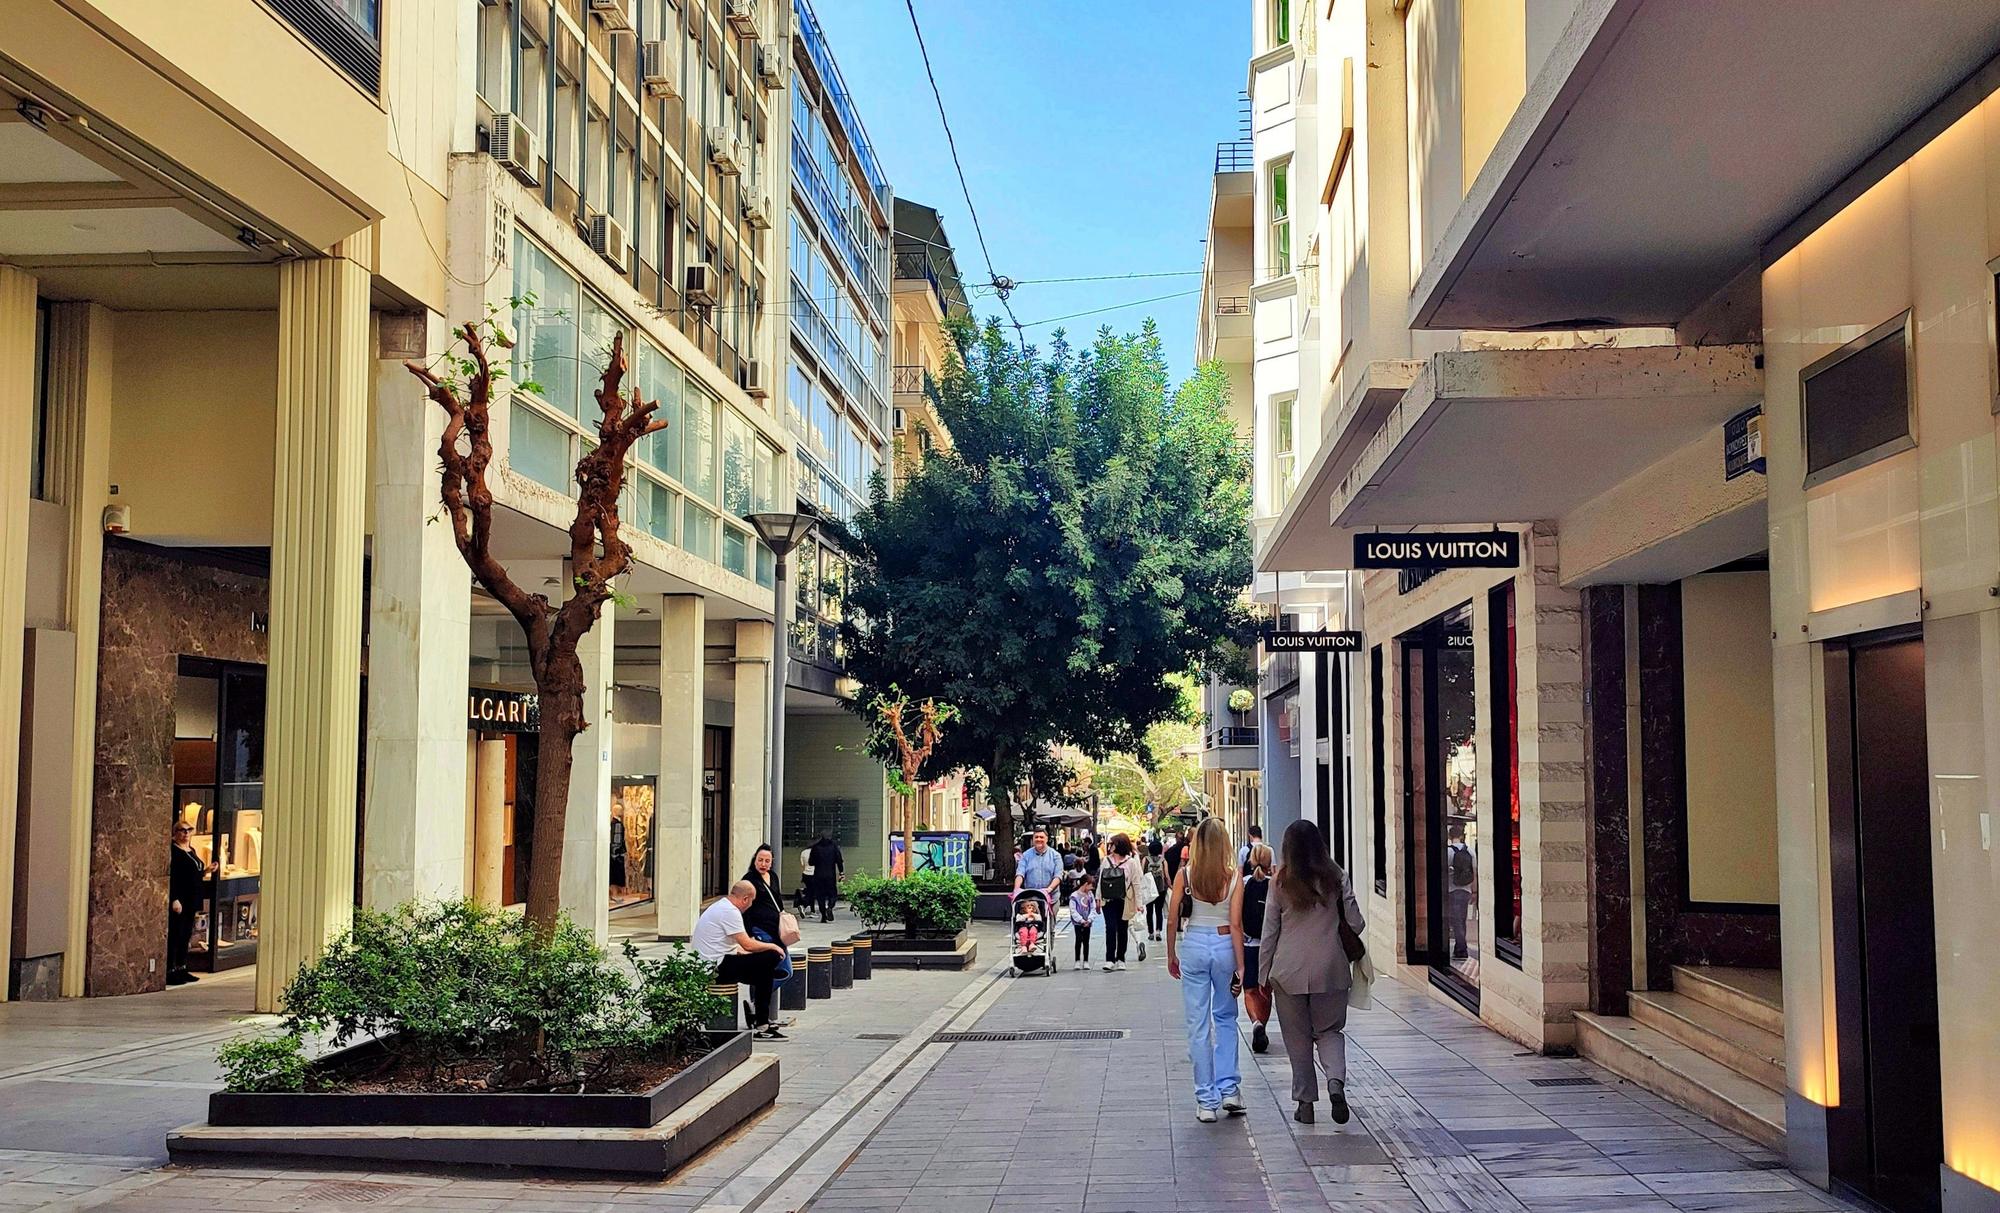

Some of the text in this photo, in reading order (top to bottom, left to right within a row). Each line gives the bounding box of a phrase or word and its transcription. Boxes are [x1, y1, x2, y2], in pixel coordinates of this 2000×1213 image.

[1367, 541, 1508, 559] LOUIS VUITTON
[1272, 636, 1355, 647] LOUIS VUITTON
[470, 696, 527, 724] LGARI
